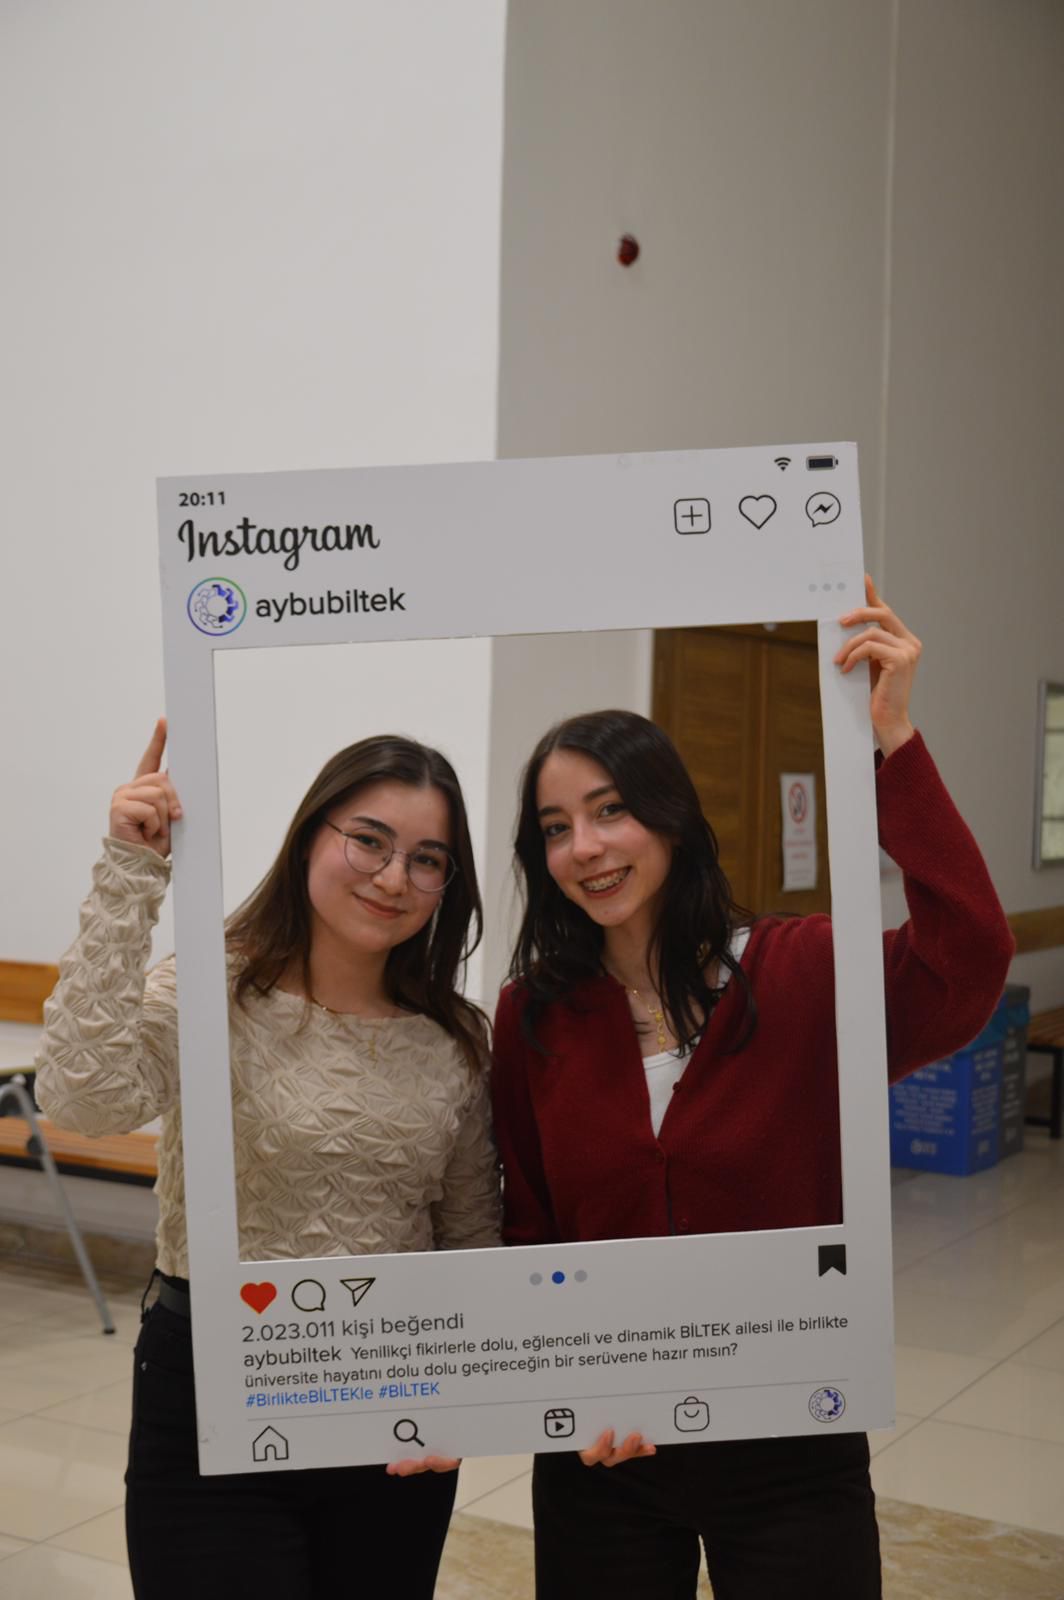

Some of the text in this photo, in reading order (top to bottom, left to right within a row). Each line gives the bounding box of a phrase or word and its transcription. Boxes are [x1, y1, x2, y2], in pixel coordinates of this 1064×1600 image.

[179, 492, 226, 507] 20:11
[178, 517, 380, 571] Instagram
[256, 588, 406, 622] aybubiltek
[242, 1313, 464, 1342] 2.023.011 kişi beğendi
[244, 1316, 848, 1369] aybubiltek Yenilikçi fikirlerle dolu, eğlenceli ve dinamik BİLTEK ailesi ile birlikte
[245, 1343, 738, 1387] üniversite hayatını dolu dolu geçireceğin bir serüvene hazır mısın?
[379, 1382, 440, 1398] #BİLTEK
